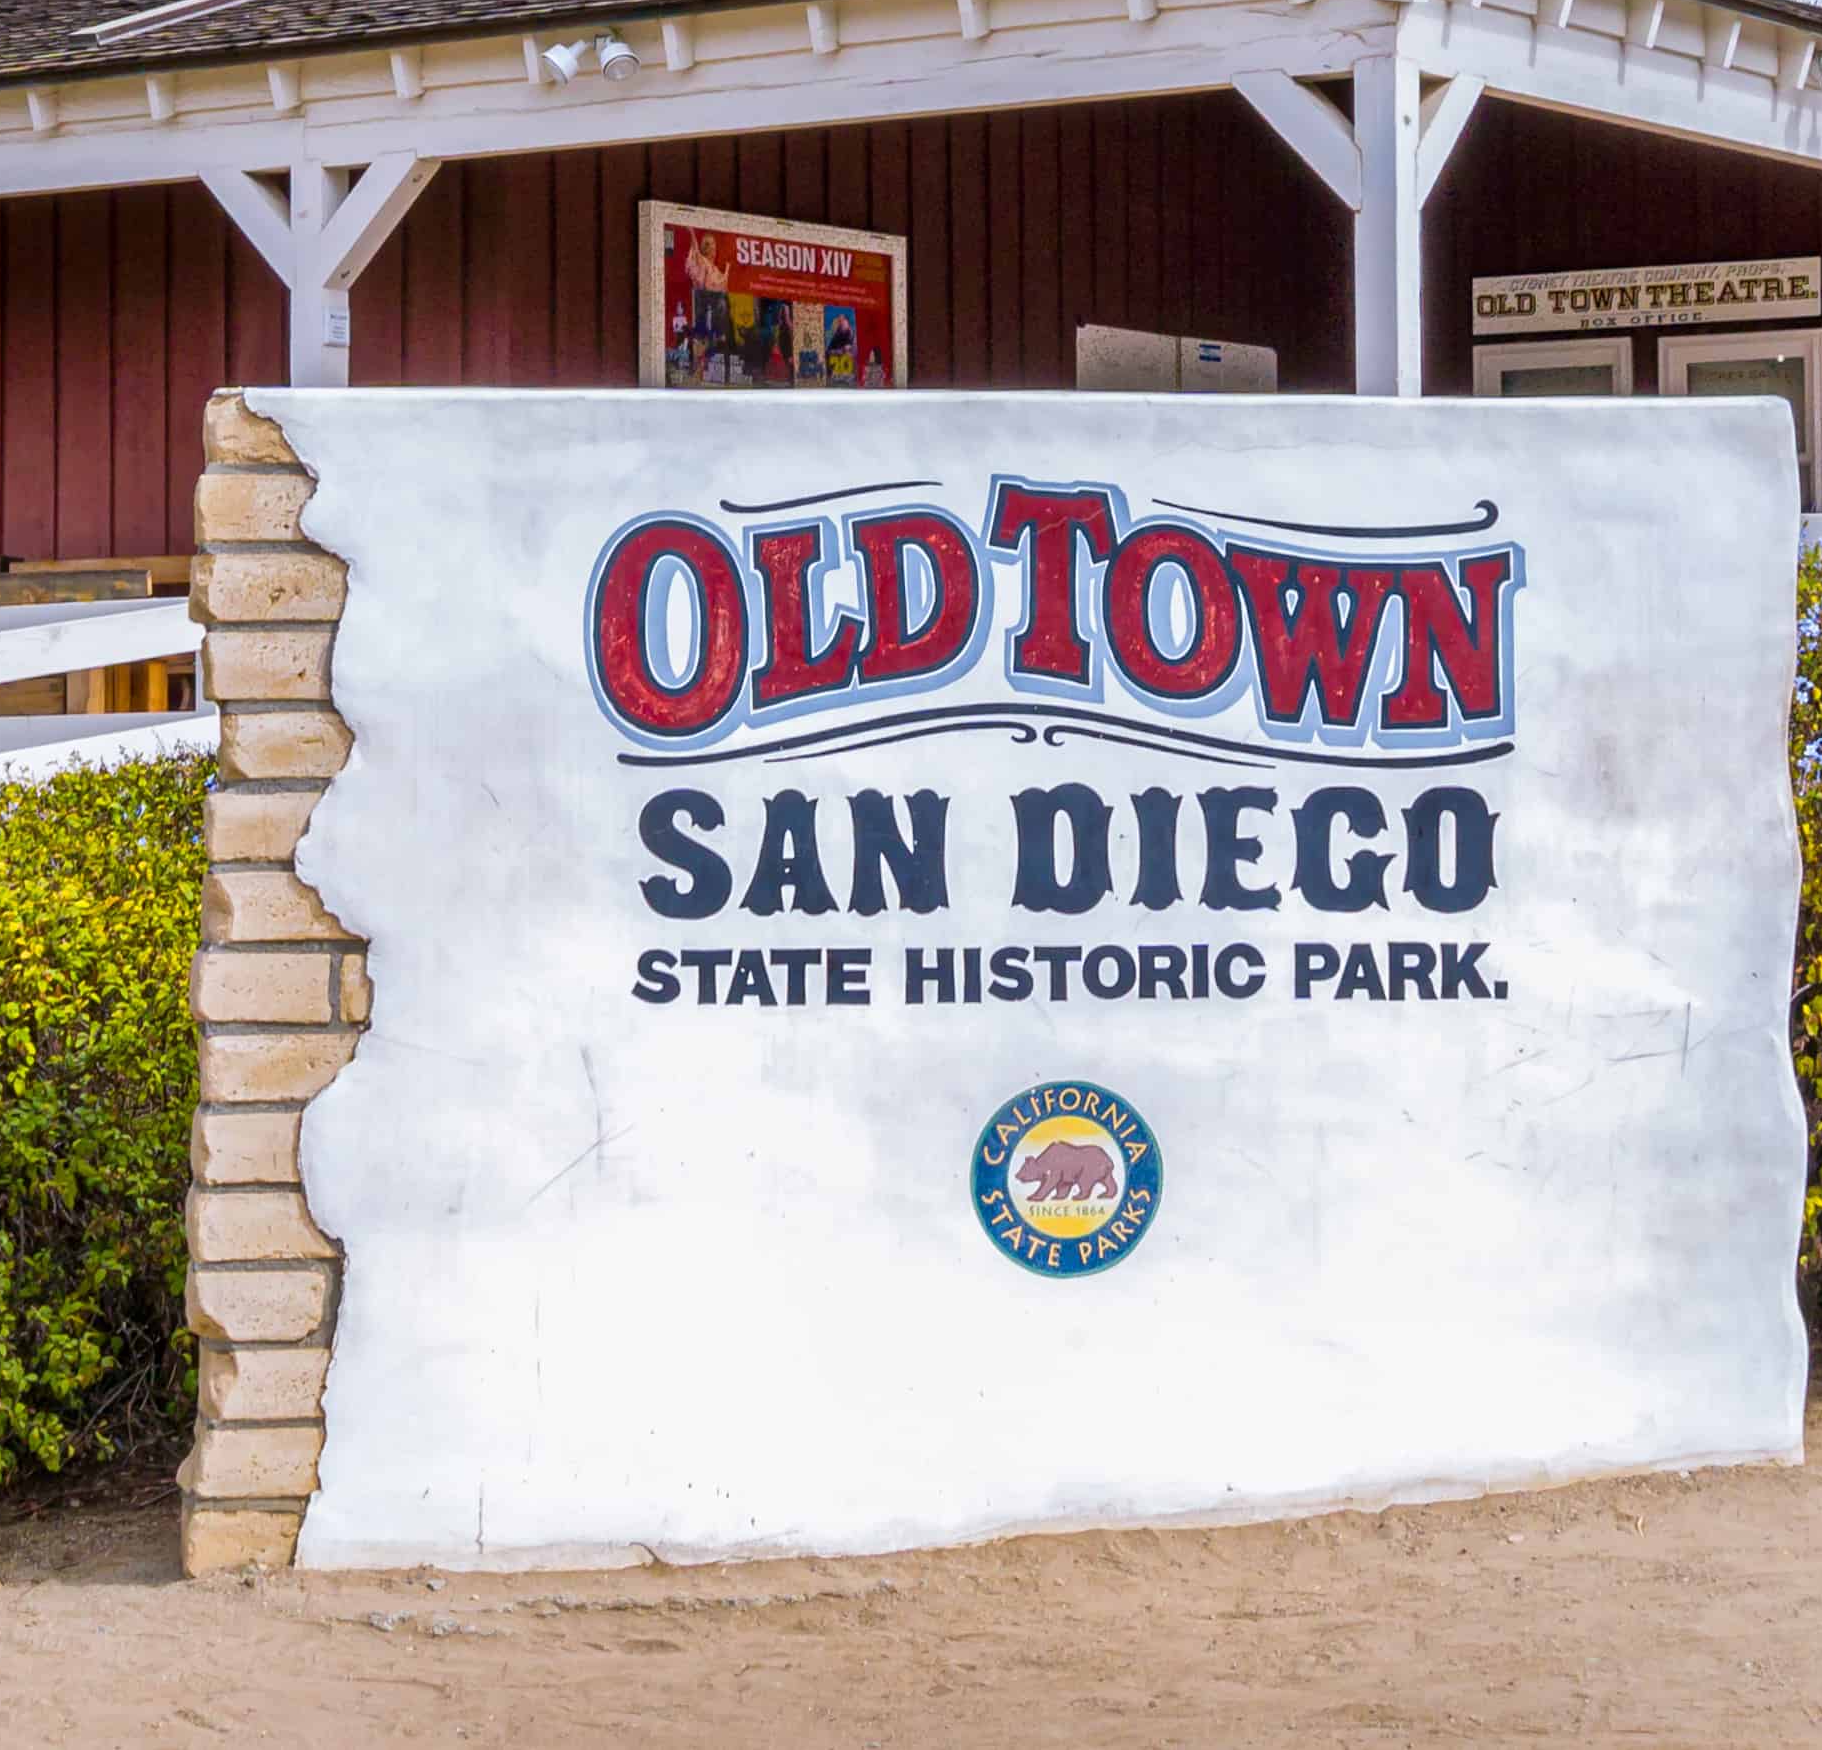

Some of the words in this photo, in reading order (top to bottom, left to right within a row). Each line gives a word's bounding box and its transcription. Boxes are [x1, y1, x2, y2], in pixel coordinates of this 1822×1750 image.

[735, 236, 817, 274] SEASON
[820, 249, 853, 278] XIV
[1573, 269, 1639, 288] THEATRE
[1476, 291, 1537, 318] OLD
[1547, 287, 1641, 315] TOWN
[1644, 274, 1819, 308] THEATRE.
[585, 500, 995, 750] OLD
[988, 472, 1527, 750] TOWN
[636, 787, 951, 921] SAN
[1008, 782, 1502, 915] DIEGO
[631, 946, 872, 1008] STATE
[904, 942, 1268, 1005] HISTORIC
[1294, 941, 1510, 1002] PARK.
[982, 1087, 1149, 1166] CALIFORNIA
[980, 1189, 1062, 1268] STATE
[1078, 1188, 1152, 1265] PARKS
[1029, 1205, 1071, 1218] SINCE
[1075, 1205, 1106, 1217] 1864
